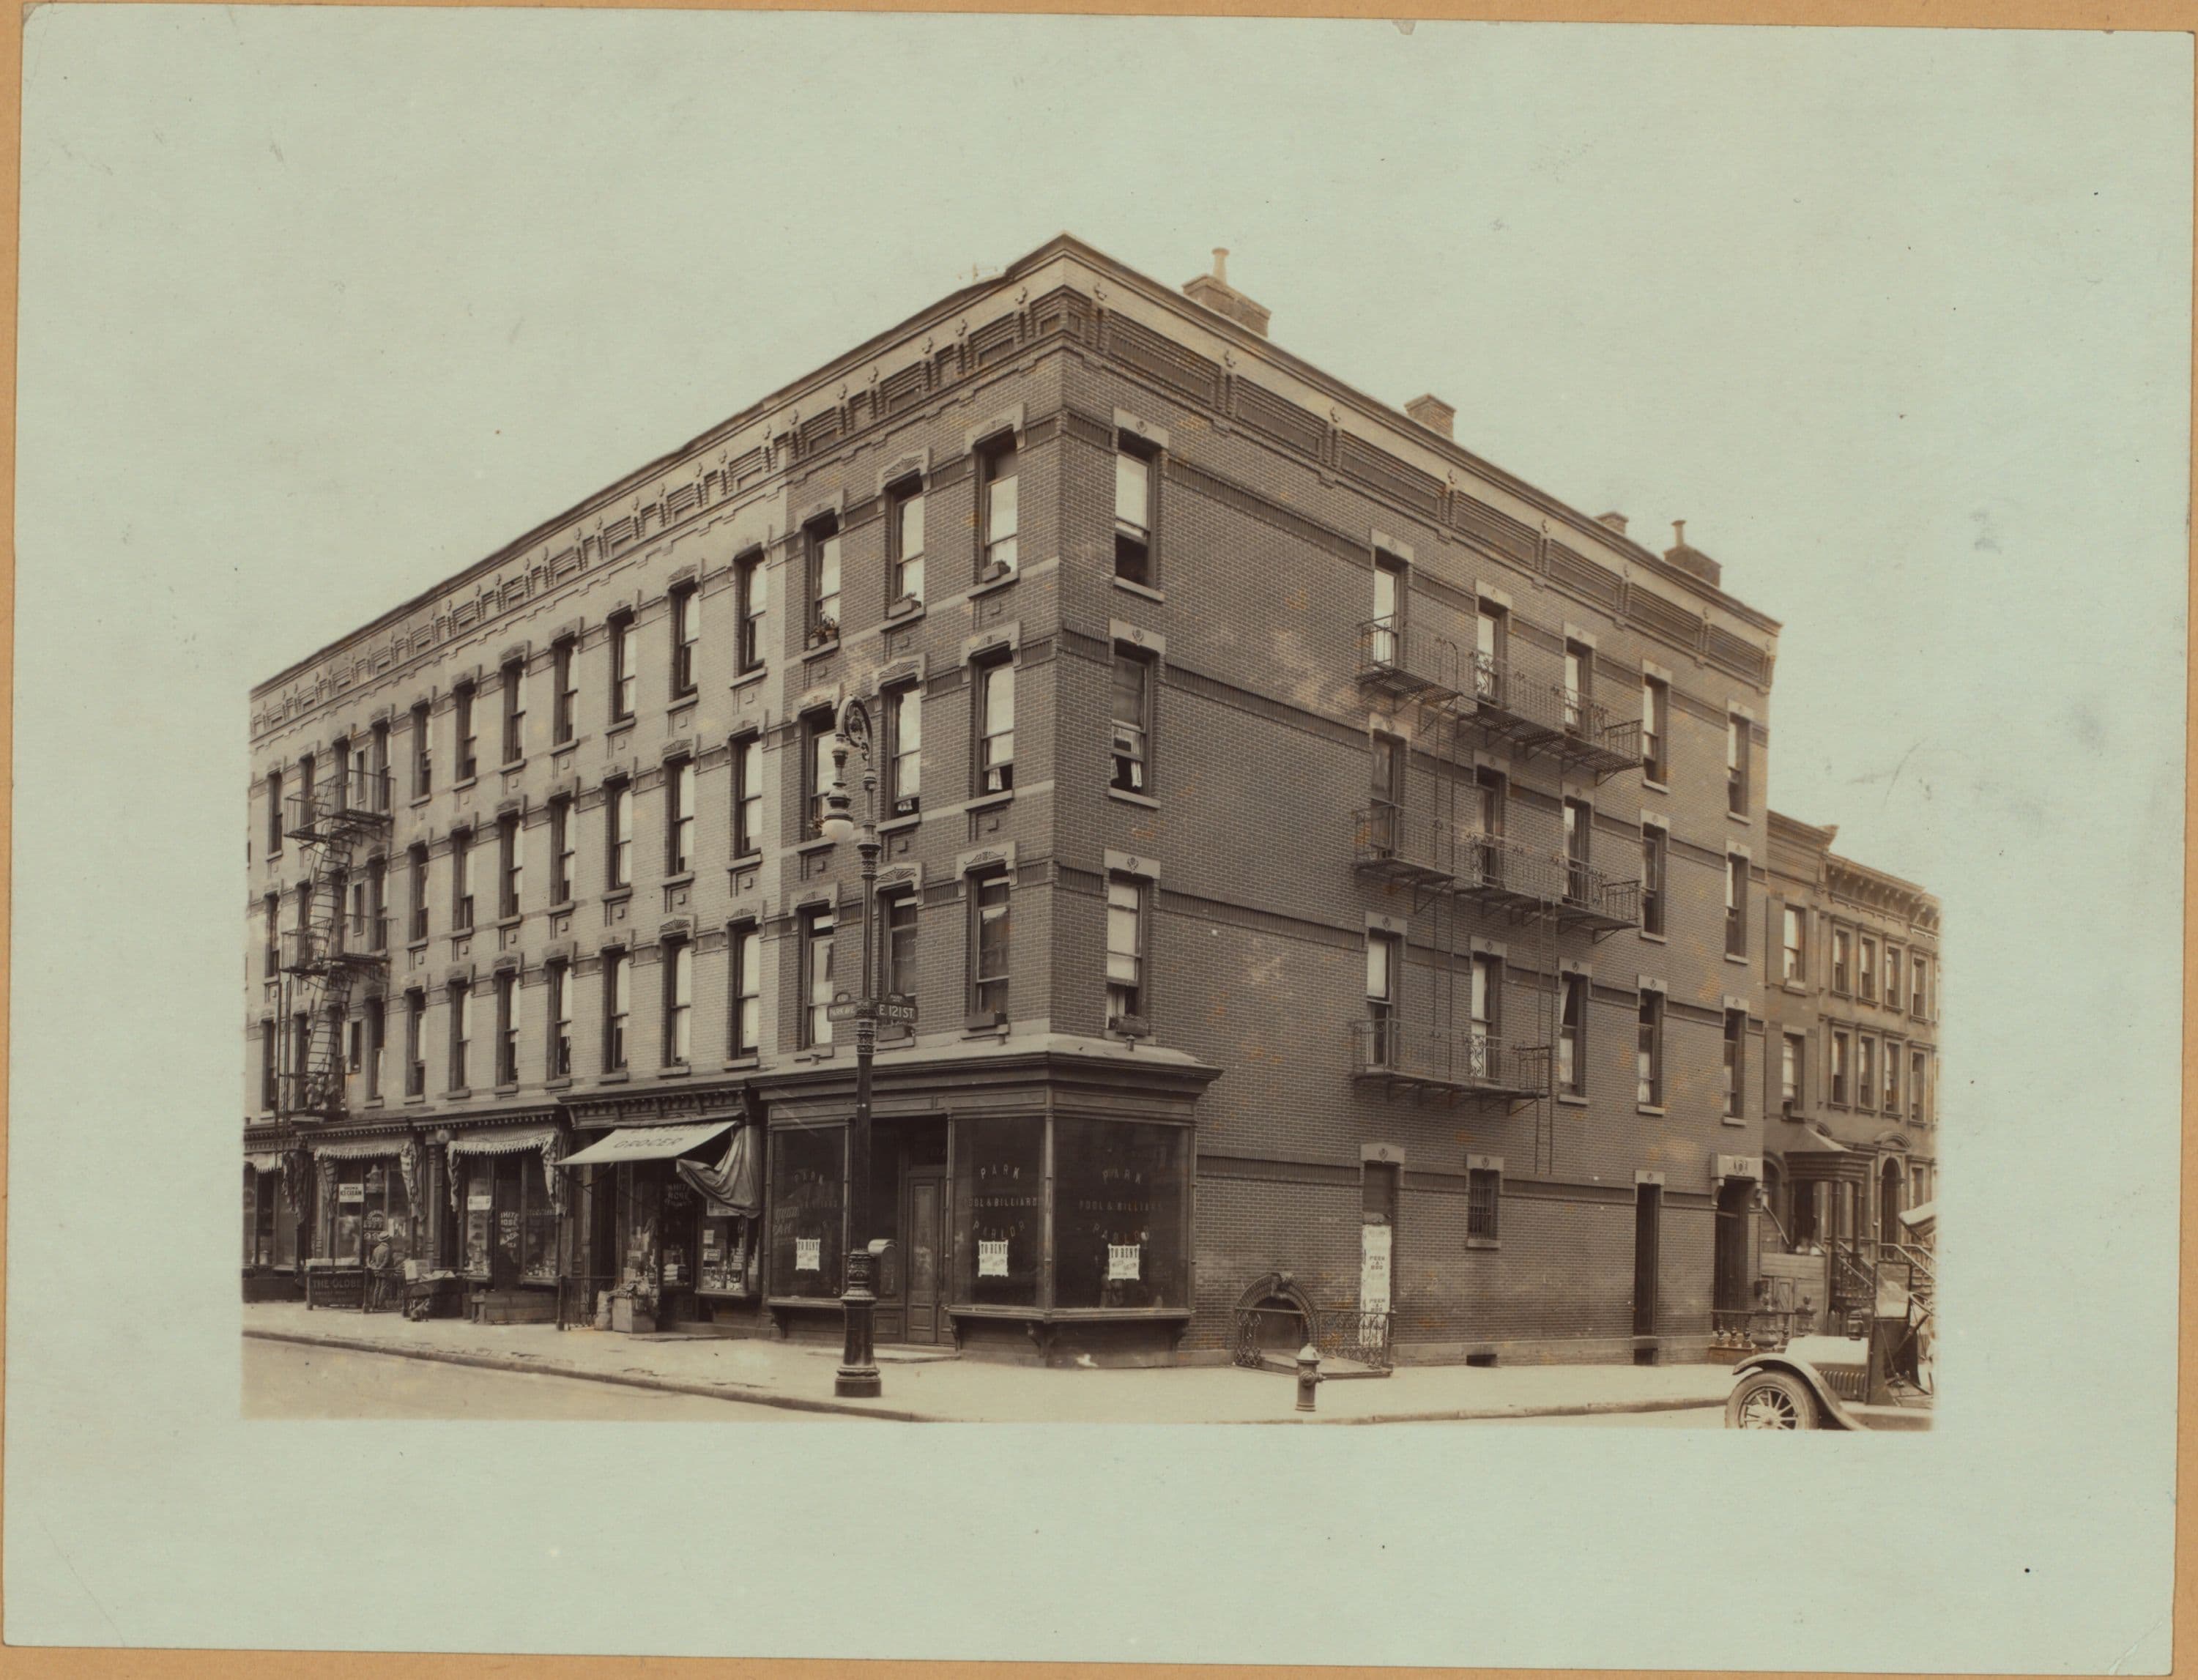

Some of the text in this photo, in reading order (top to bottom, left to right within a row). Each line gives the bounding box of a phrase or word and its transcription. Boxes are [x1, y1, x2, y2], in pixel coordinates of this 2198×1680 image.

[889, 1006, 902, 1017] 121
[980, 1163, 1020, 1180] PARK
[1102, 1168, 1143, 1184] PARK
[994, 1197, 1037, 1208] BILLIARD
[981, 1244, 1006, 1255] TO RENT
[1111, 1248, 1137, 1258] TO RENT
